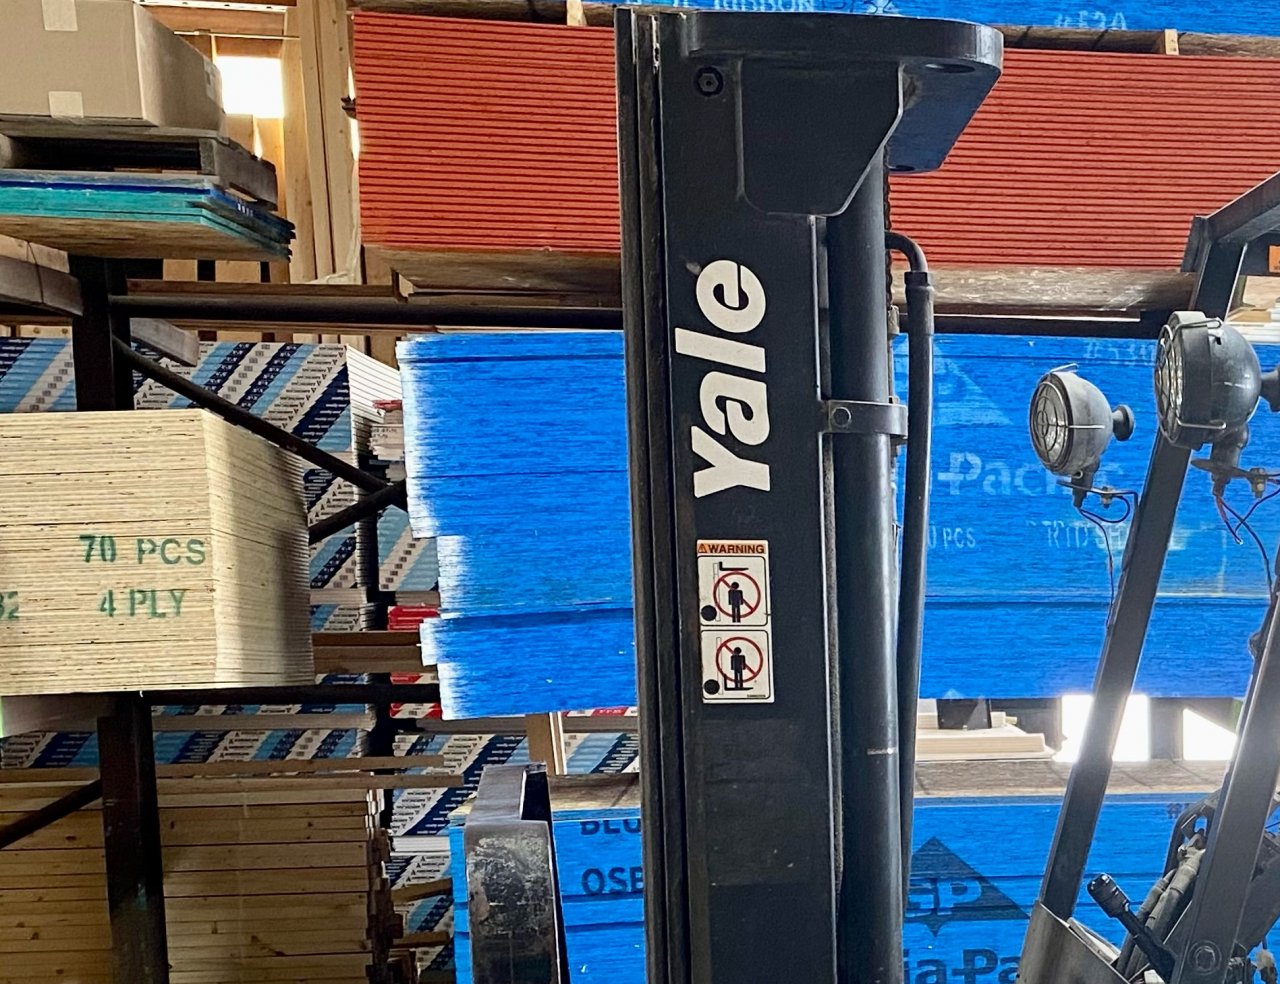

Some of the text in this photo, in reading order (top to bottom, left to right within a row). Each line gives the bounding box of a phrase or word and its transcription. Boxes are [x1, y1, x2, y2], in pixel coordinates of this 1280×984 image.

[675, 260, 771, 498] Yale
[79, 534, 206, 565] 70 PCS
[708, 544, 764, 554] WARNING
[100, 588, 188, 618] 4 PLY
[580, 818, 641, 835] BLU
